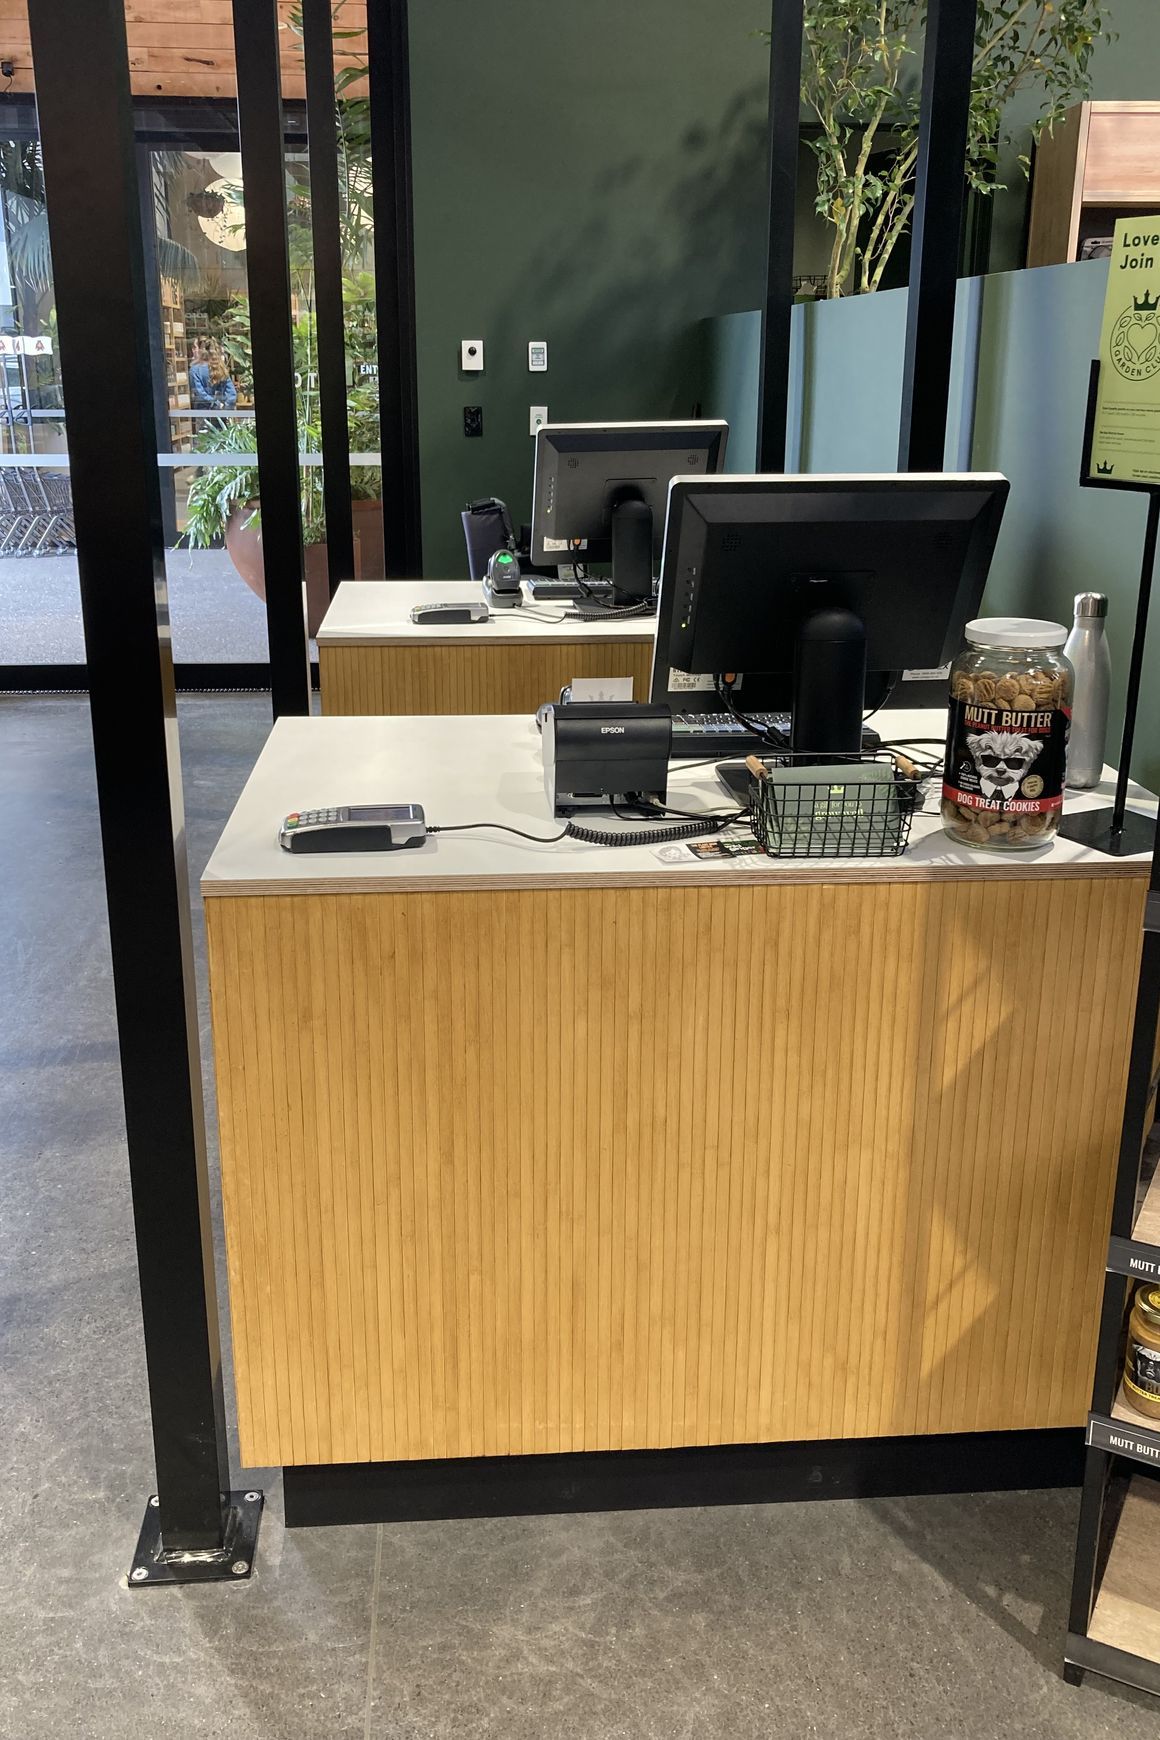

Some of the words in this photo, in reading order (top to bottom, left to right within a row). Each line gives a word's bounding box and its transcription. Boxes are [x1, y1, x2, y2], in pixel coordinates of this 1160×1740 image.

[1123, 233, 1160, 247] Love
[1120, 252, 1154, 269] Join
[1114, 350, 1142, 376] GARDEN
[964, 706, 999, 725] MUTT
[1001, 711, 1052, 728] BUTTER
[957, 792, 972, 806] DOG
[974, 796, 1001, 811] TREAT
[1003, 801, 1040, 812] COOKIES
[815, 811, 841, 820] grow
[1129, 1258, 1156, 1273] MUTT
[1109, 1435, 1135, 1450] MUTT
